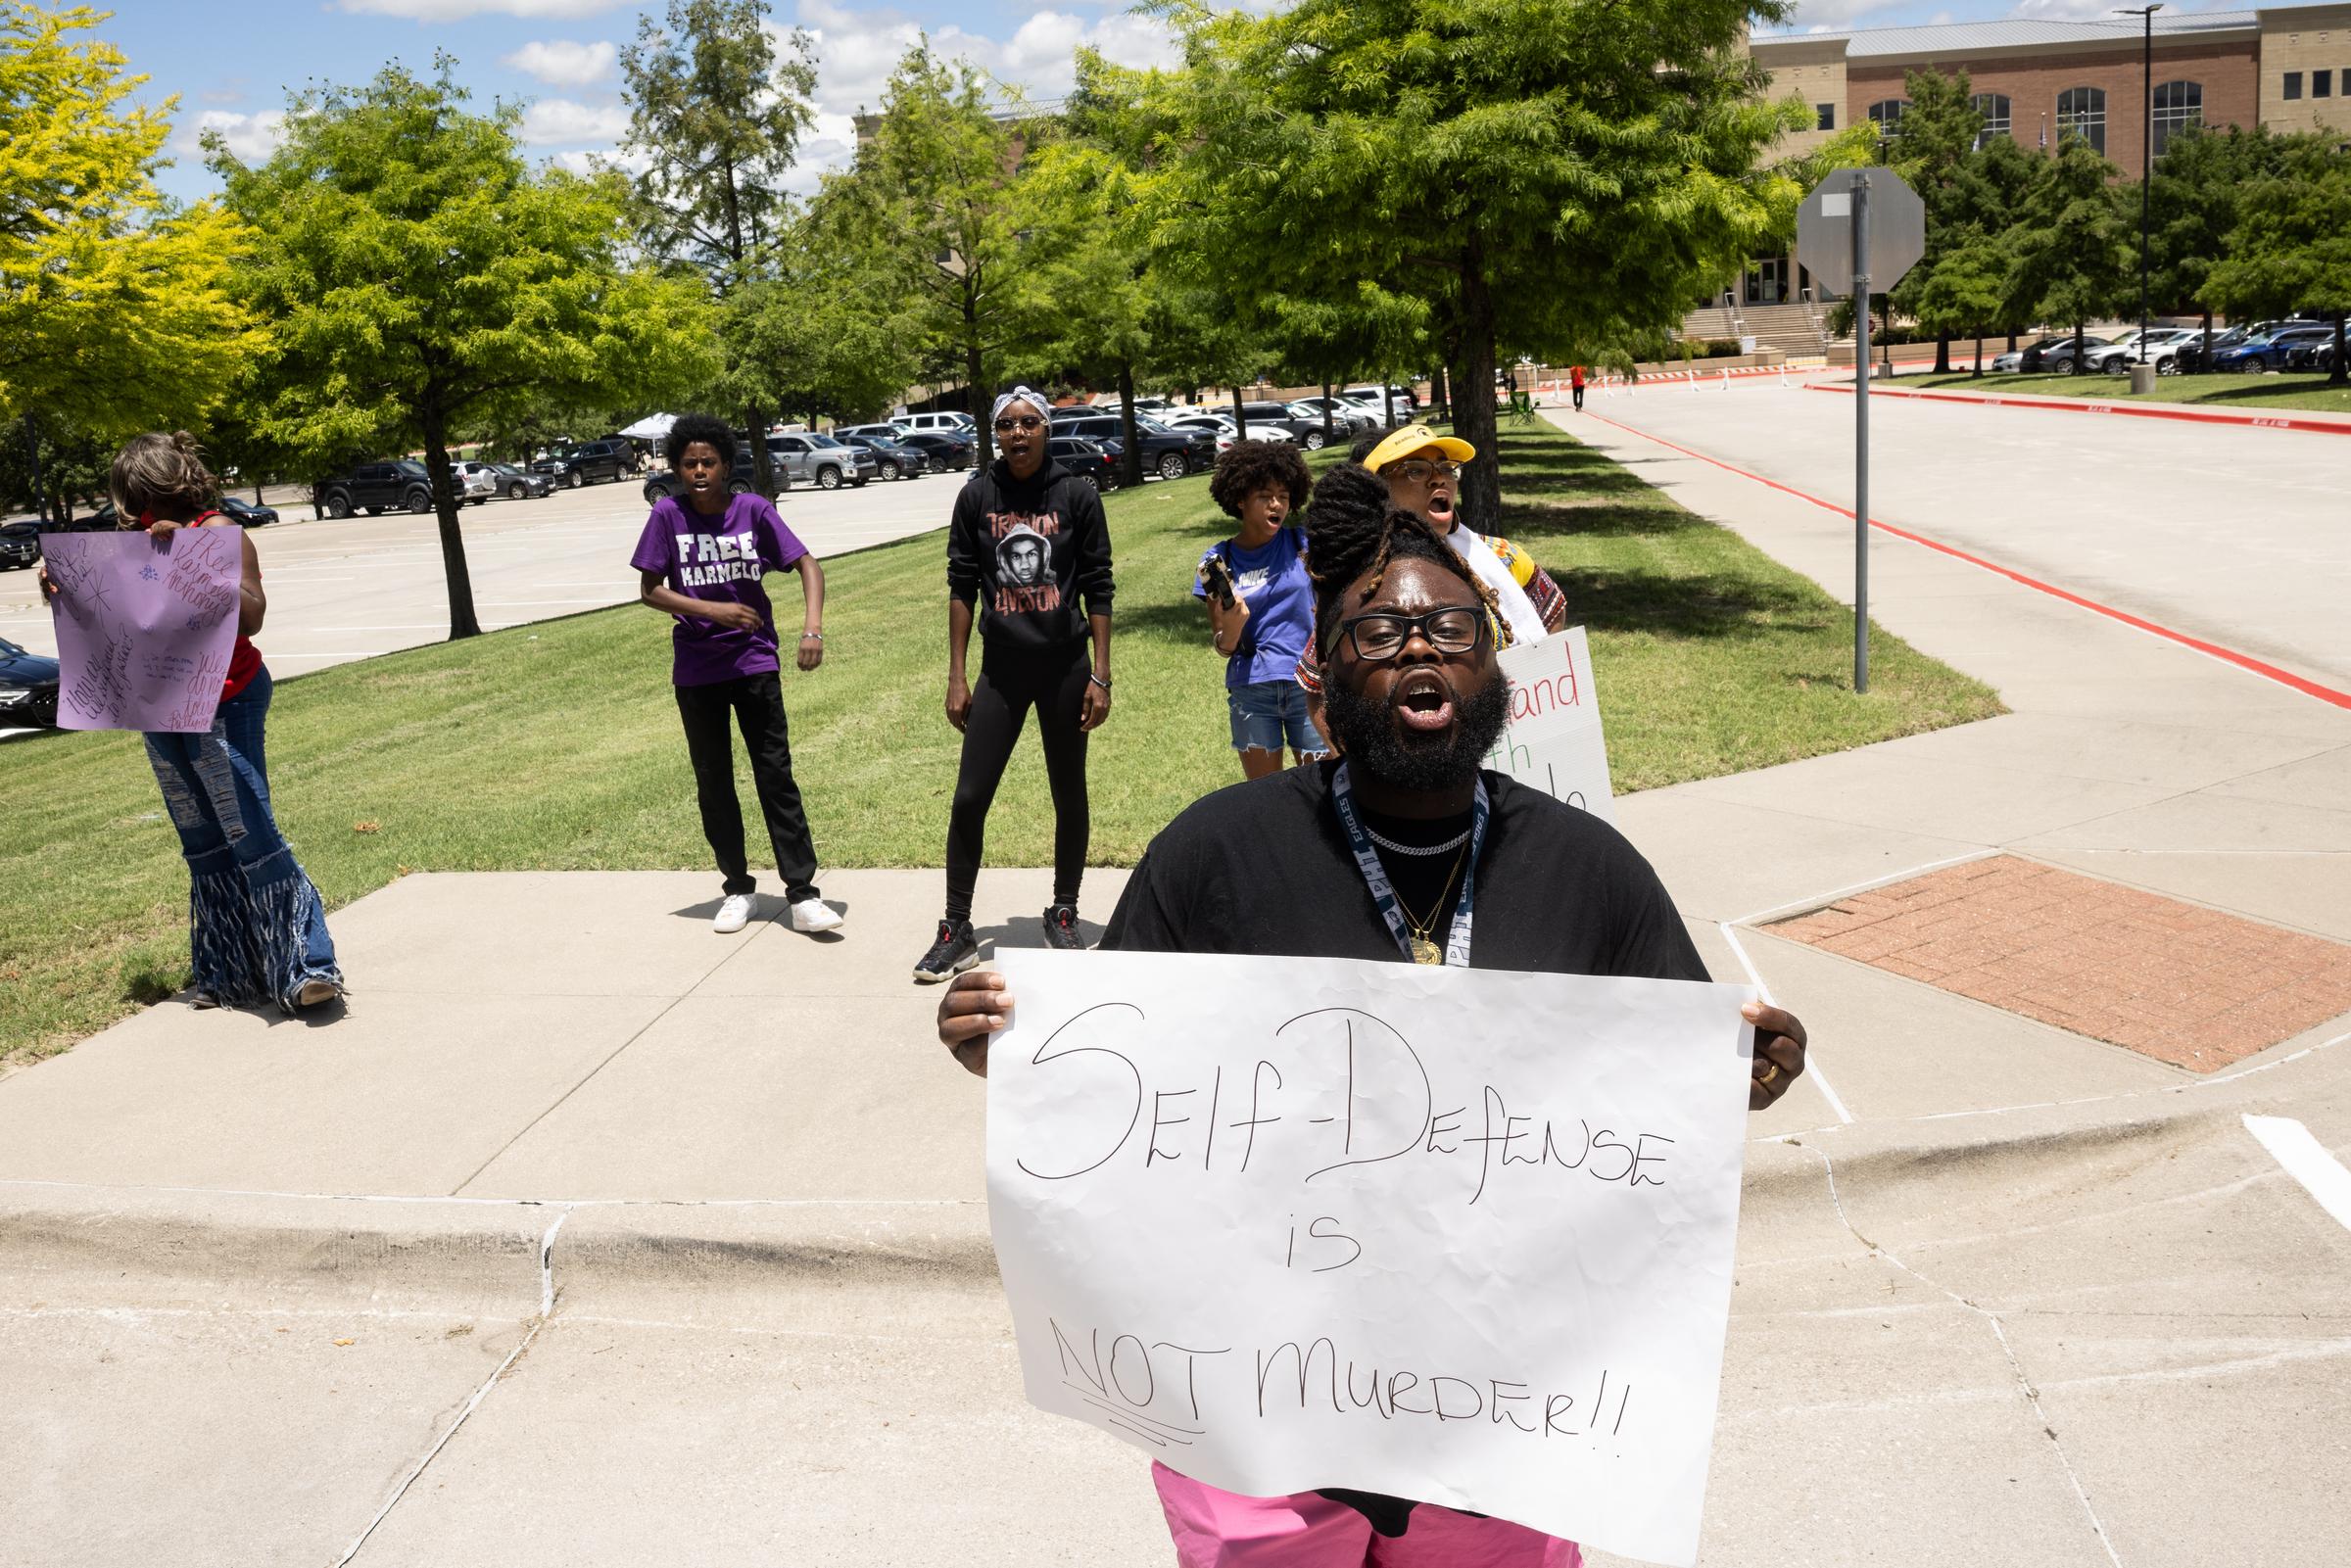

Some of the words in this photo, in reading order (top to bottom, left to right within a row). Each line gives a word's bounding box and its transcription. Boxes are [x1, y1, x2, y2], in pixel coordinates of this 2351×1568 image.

[676, 531, 758, 563] FREE
[681, 560, 761, 587] KARMELO
[1238, 565, 1270, 588] NIKE
[1507, 641, 1579, 726] and
[1484, 734, 1531, 774] th
[1339, 797, 1365, 843] EAGLES
[1472, 813, 1485, 855] EAGL
[1050, 1318, 1231, 1421] NOT
[1257, 1338, 1631, 1458] MURDER!!
